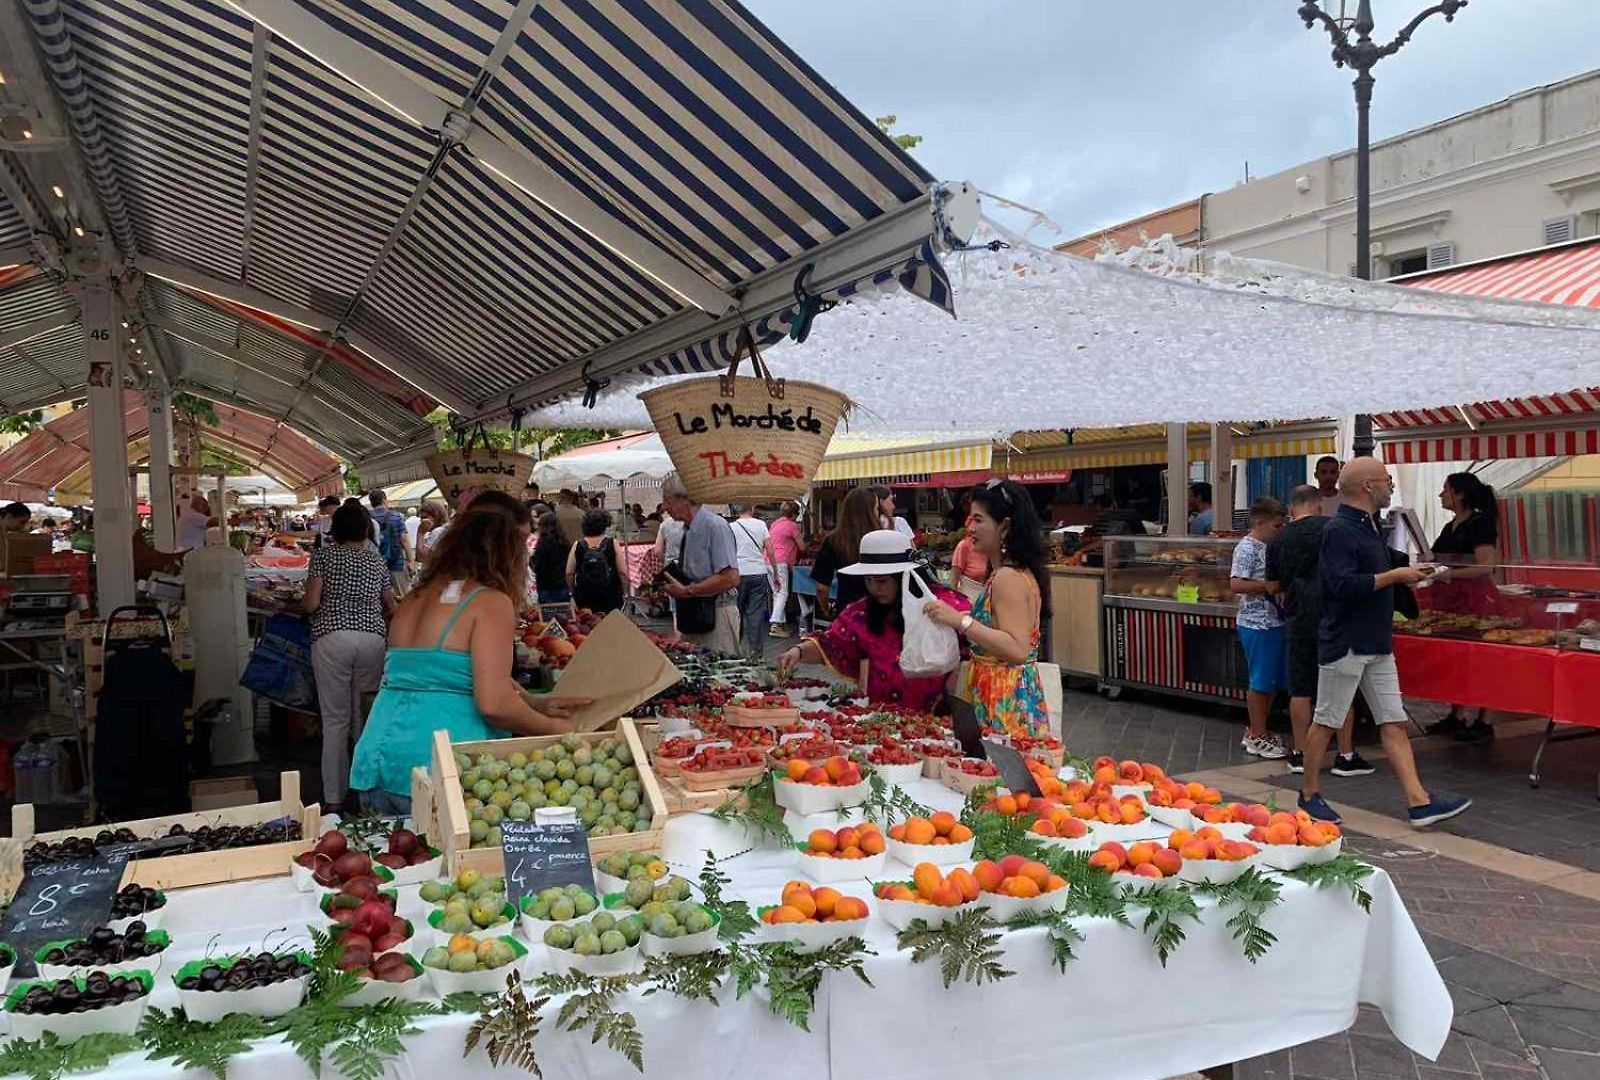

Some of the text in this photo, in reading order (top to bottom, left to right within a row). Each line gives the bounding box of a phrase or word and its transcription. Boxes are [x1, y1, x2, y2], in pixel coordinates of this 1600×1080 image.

[90, 328, 109, 341] 46
[673, 402, 822, 436] Le Marché de
[442, 460, 516, 477] Le Marché
[698, 450, 804, 479] Thérèse
